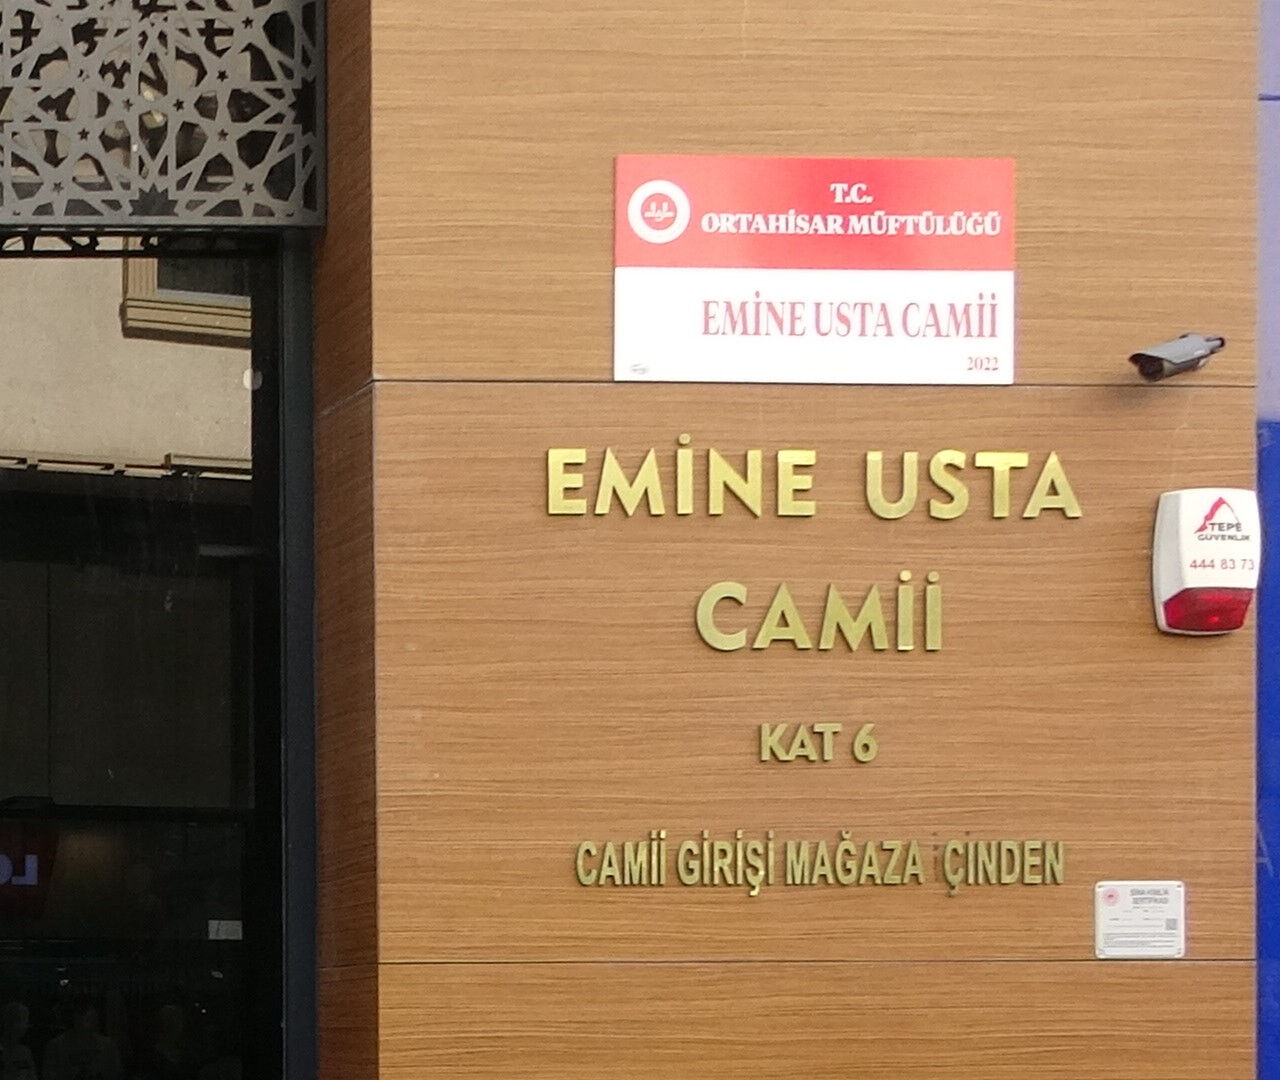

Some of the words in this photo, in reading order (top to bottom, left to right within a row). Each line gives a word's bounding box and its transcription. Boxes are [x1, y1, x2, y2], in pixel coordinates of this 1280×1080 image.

[829, 182, 873, 204] T.C.
[700, 208, 845, 236] ORTAHİSAR
[848, 210, 1002, 237] MÜFTÜLÜĞÜ
[701, 289, 806, 338] EMİNE
[814, 300, 894, 339] USTA
[901, 291, 999, 339] CAMİİ
[966, 355, 1000, 372] 2022
[545, 433, 819, 519] EMİNE
[864, 448, 1083, 521] USTA
[1208, 522, 1242, 532] TEPE
[1189, 558, 1216, 570] 444
[1220, 558, 1237, 570] 83
[1241, 558, 1255, 571] 73
[694, 568, 945, 653] CAMİİ
[758, 721, 842, 764] KAT
[852, 721, 879, 764] 6
[574, 828, 668, 886] CAMİİ
[676, 828, 776, 898] GİRİŞİ
[784, 829, 926, 886] MAĞAZA
